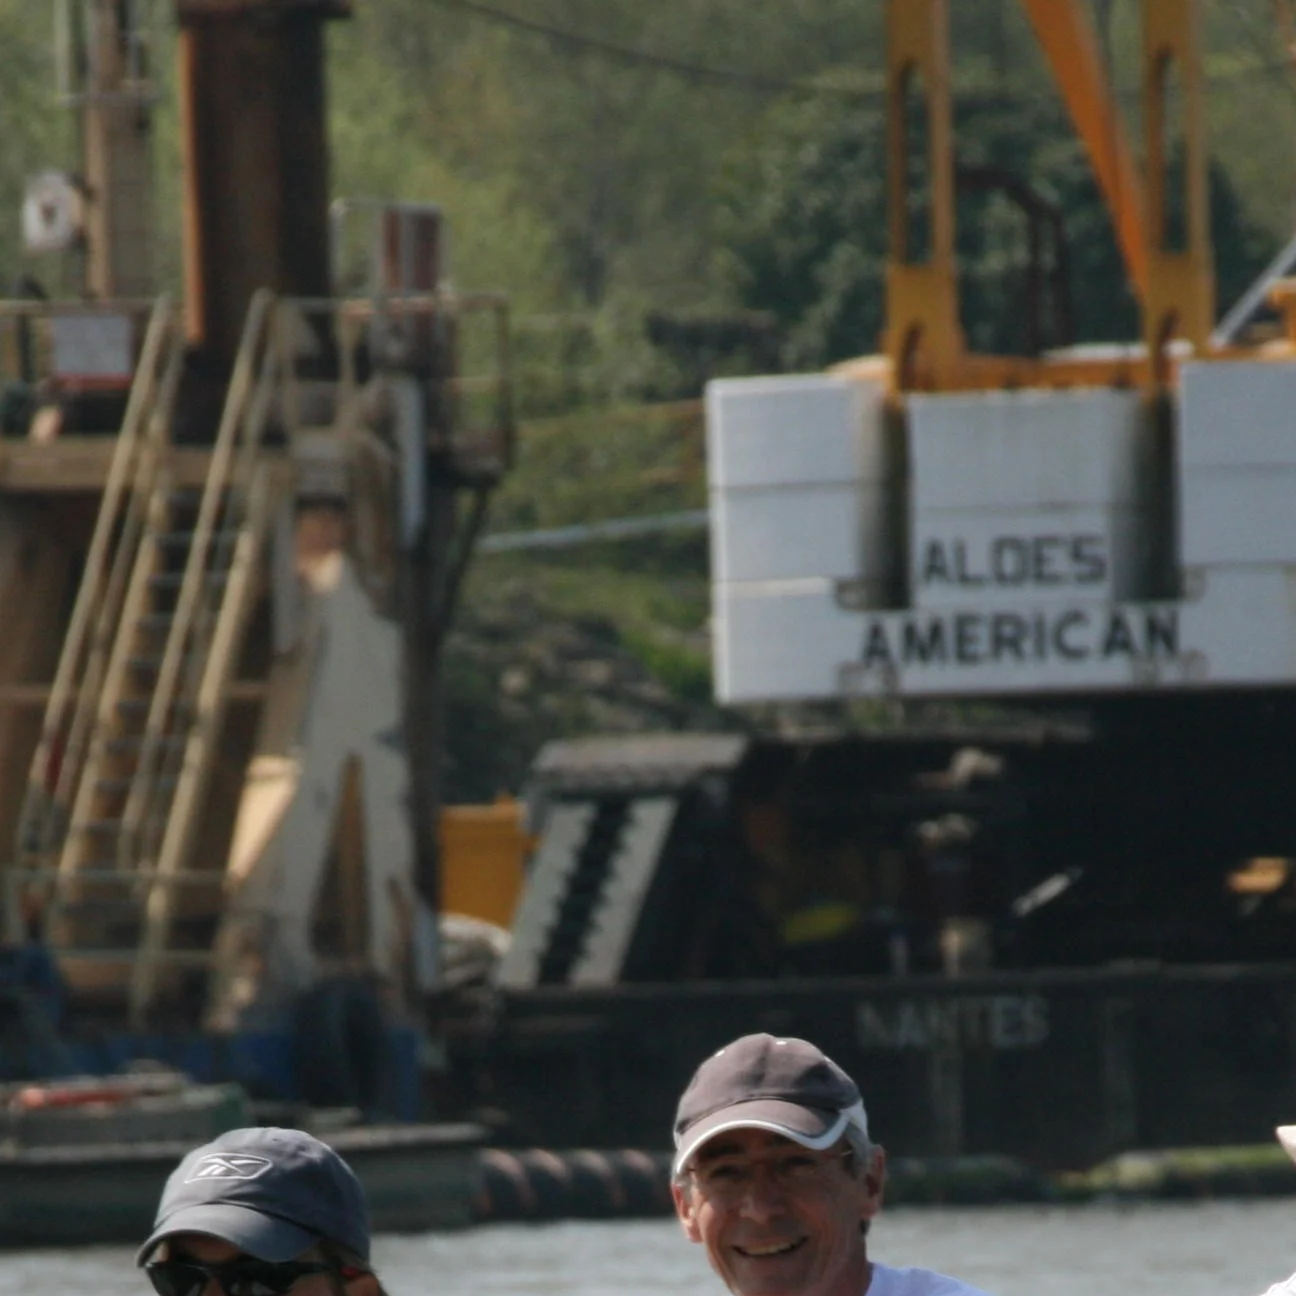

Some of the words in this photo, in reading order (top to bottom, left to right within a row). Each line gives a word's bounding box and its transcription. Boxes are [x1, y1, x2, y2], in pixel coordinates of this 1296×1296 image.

[922, 535, 1107, 586] ALOES
[861, 608, 1180, 668] AMERICAN
[856, 996, 1050, 1048] NANTES
